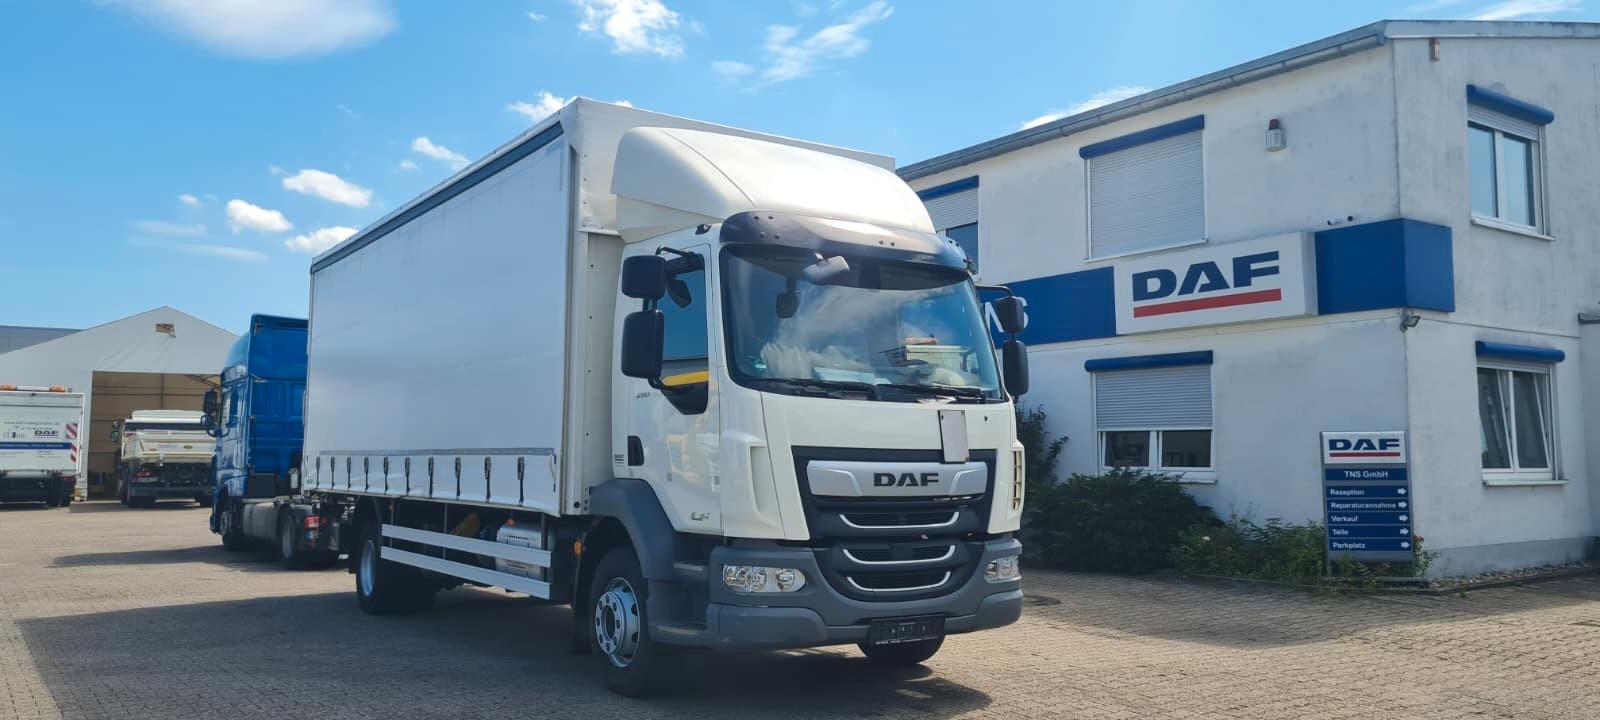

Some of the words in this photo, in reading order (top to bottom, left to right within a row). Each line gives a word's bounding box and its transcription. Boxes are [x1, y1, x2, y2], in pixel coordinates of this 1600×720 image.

[1132, 251, 1280, 302] DAF
[1328, 438, 1400, 451] DAF
[1343, 470, 1361, 478] TNS
[1362, 470, 1389, 478] GmbH
[873, 472, 939, 487] DAF
[1330, 501, 1397, 510] Reparaturannahme
[1332, 528, 1349, 536] Teile
[1333, 542, 1366, 550] Parkplatz
